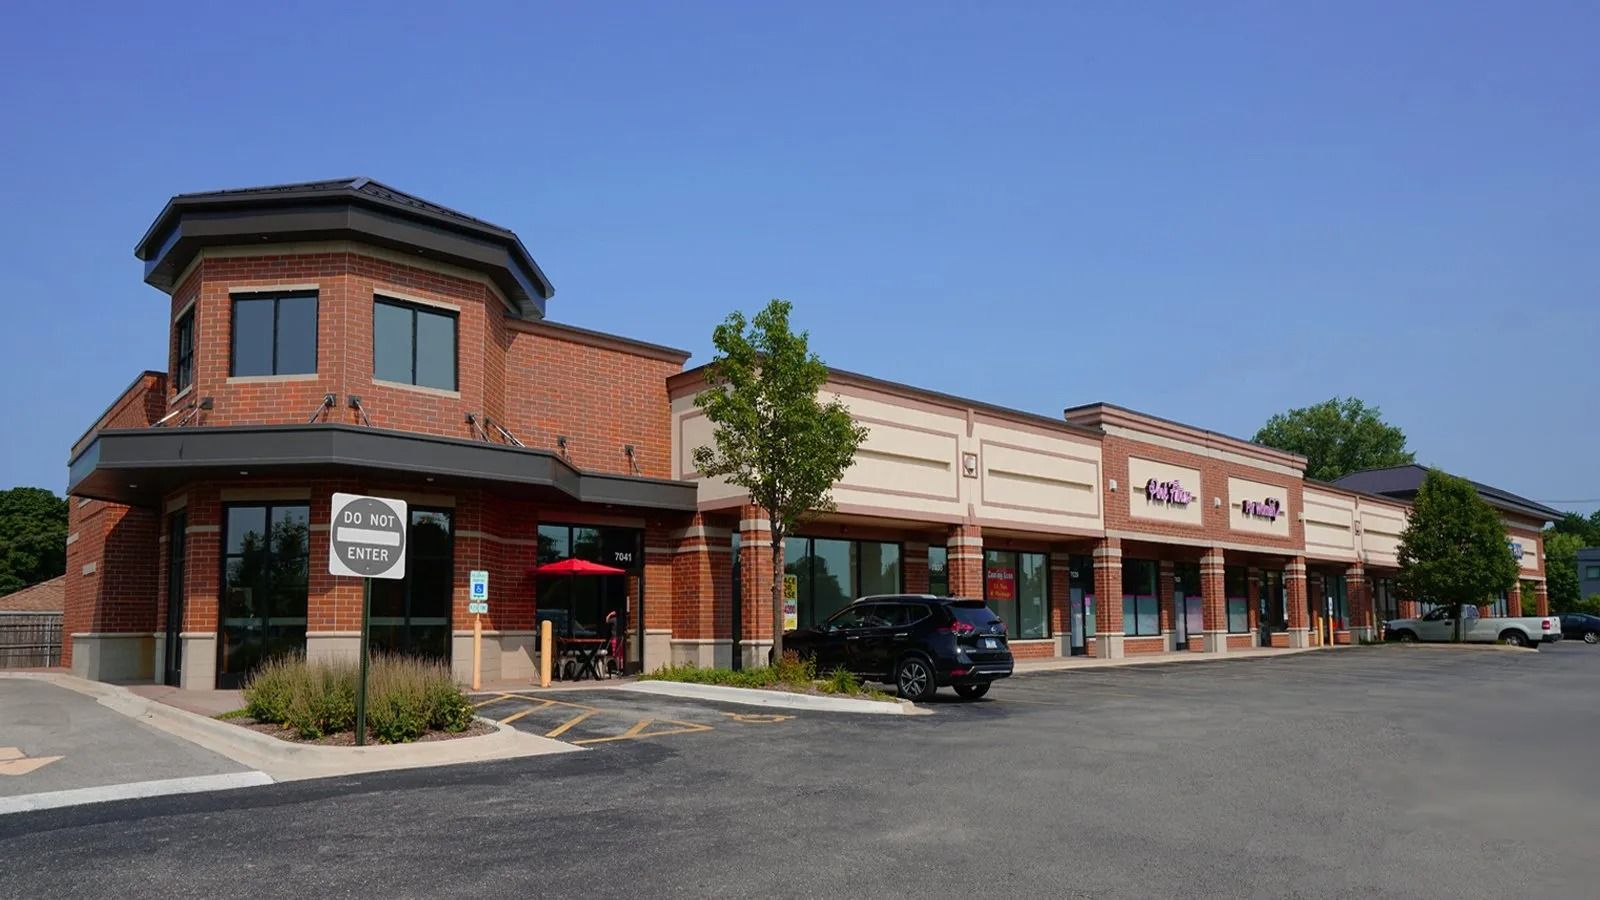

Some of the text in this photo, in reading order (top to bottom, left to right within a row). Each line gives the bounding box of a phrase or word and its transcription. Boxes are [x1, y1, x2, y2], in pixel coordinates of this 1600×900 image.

[344, 511, 395, 527] DO NOT
[347, 546, 389, 561] ENTER
[615, 551, 632, 561] 7041
